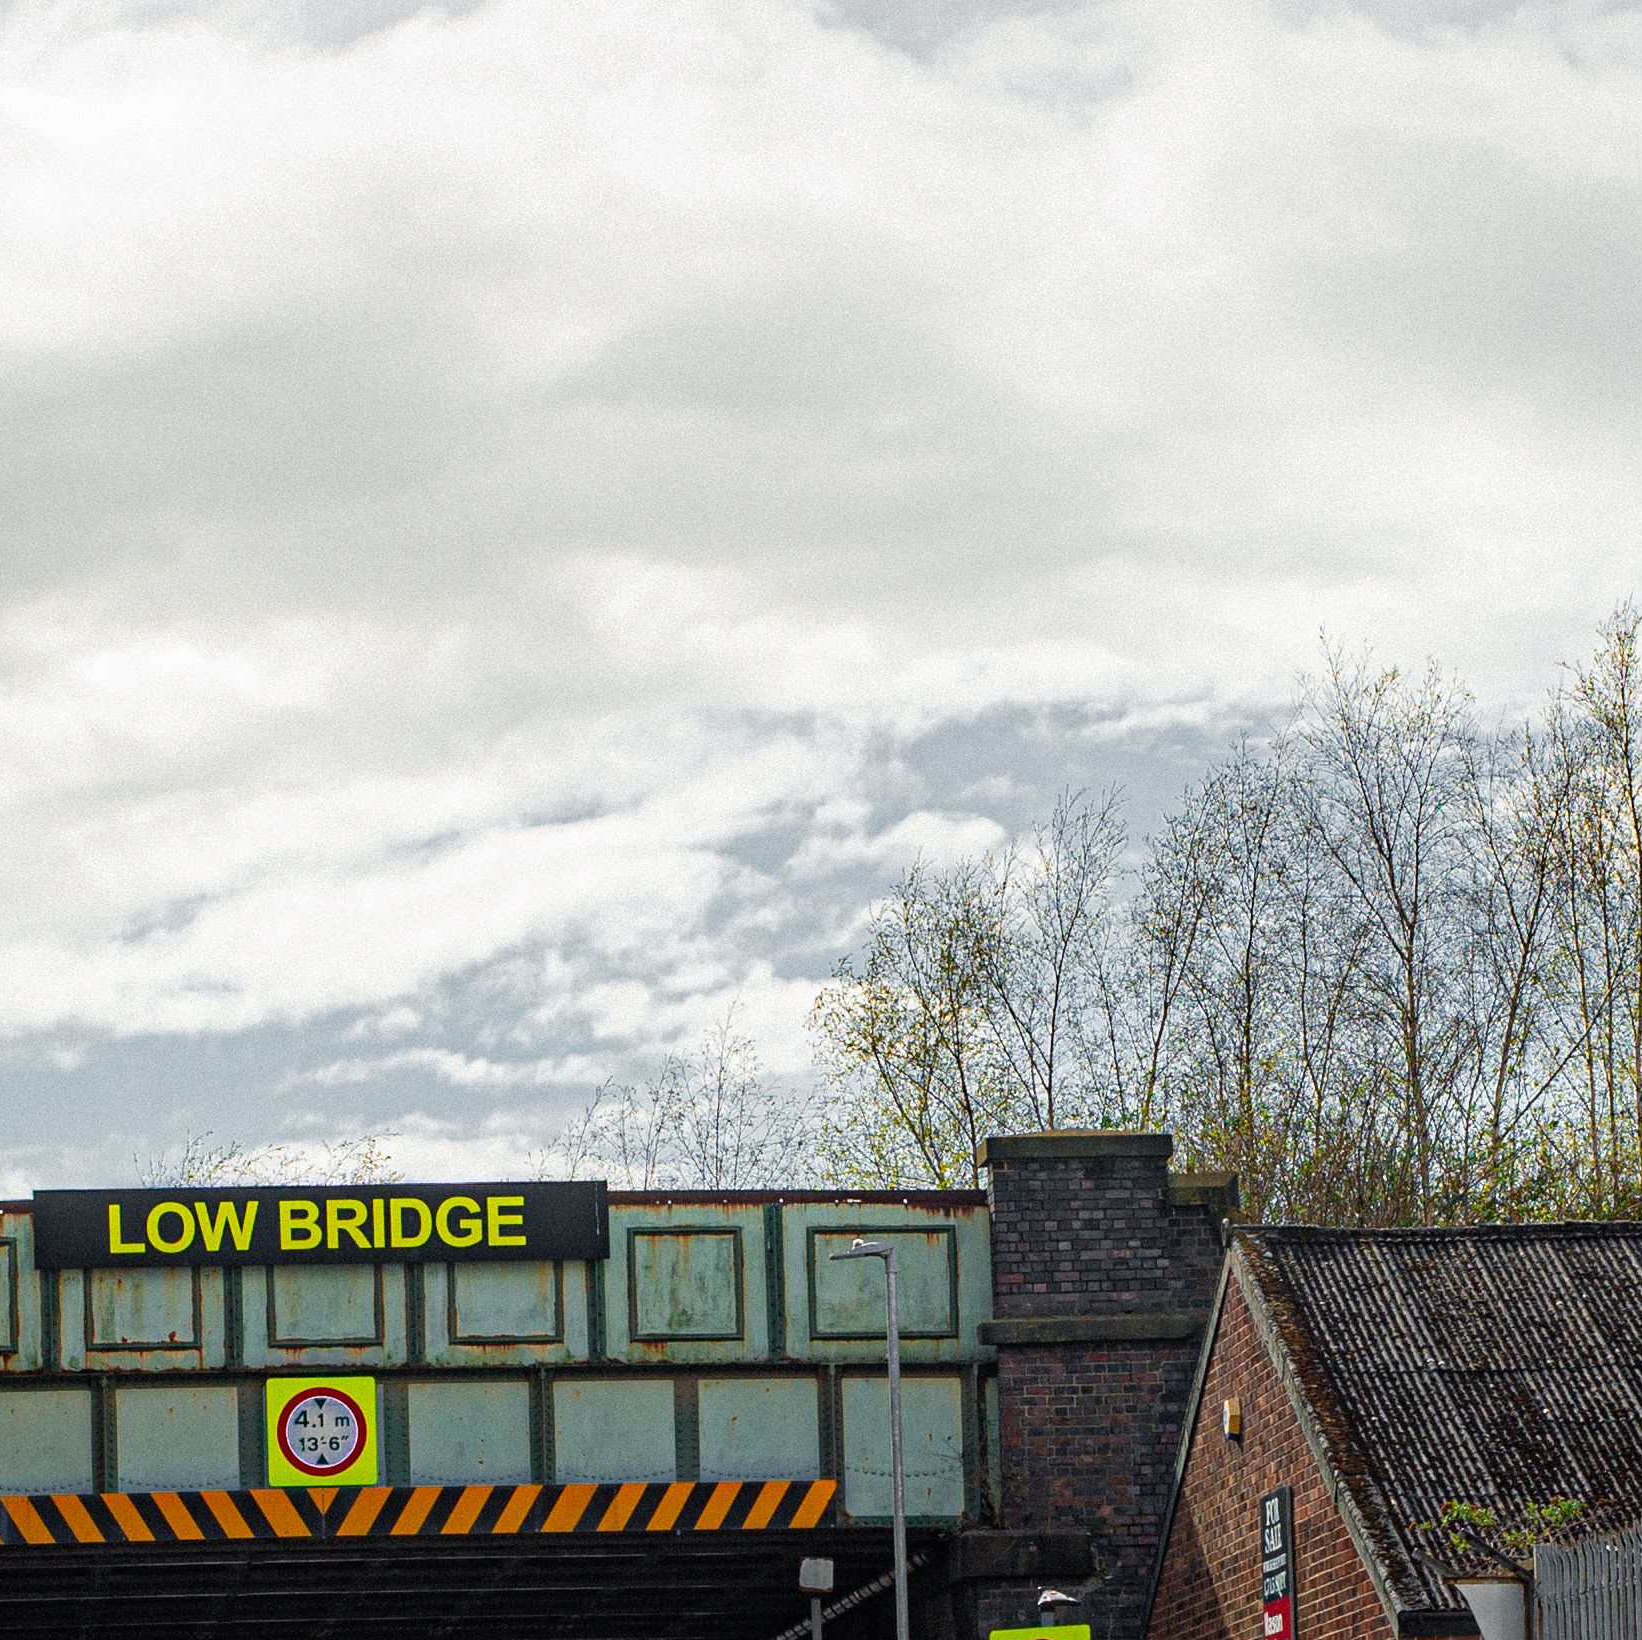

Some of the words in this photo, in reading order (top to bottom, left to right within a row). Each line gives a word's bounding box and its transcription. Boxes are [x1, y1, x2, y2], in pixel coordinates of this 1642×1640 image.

[108, 1201, 259, 1254] LOW
[278, 1196, 527, 1250] BRIDGE
[294, 1410, 324, 1428] 4.1
[335, 1415, 351, 1428] m
[298, 1435, 349, 1452] 13'-6"
[1265, 1497, 1280, 1527] FOR
[1264, 1522, 1283, 1554] SALE
